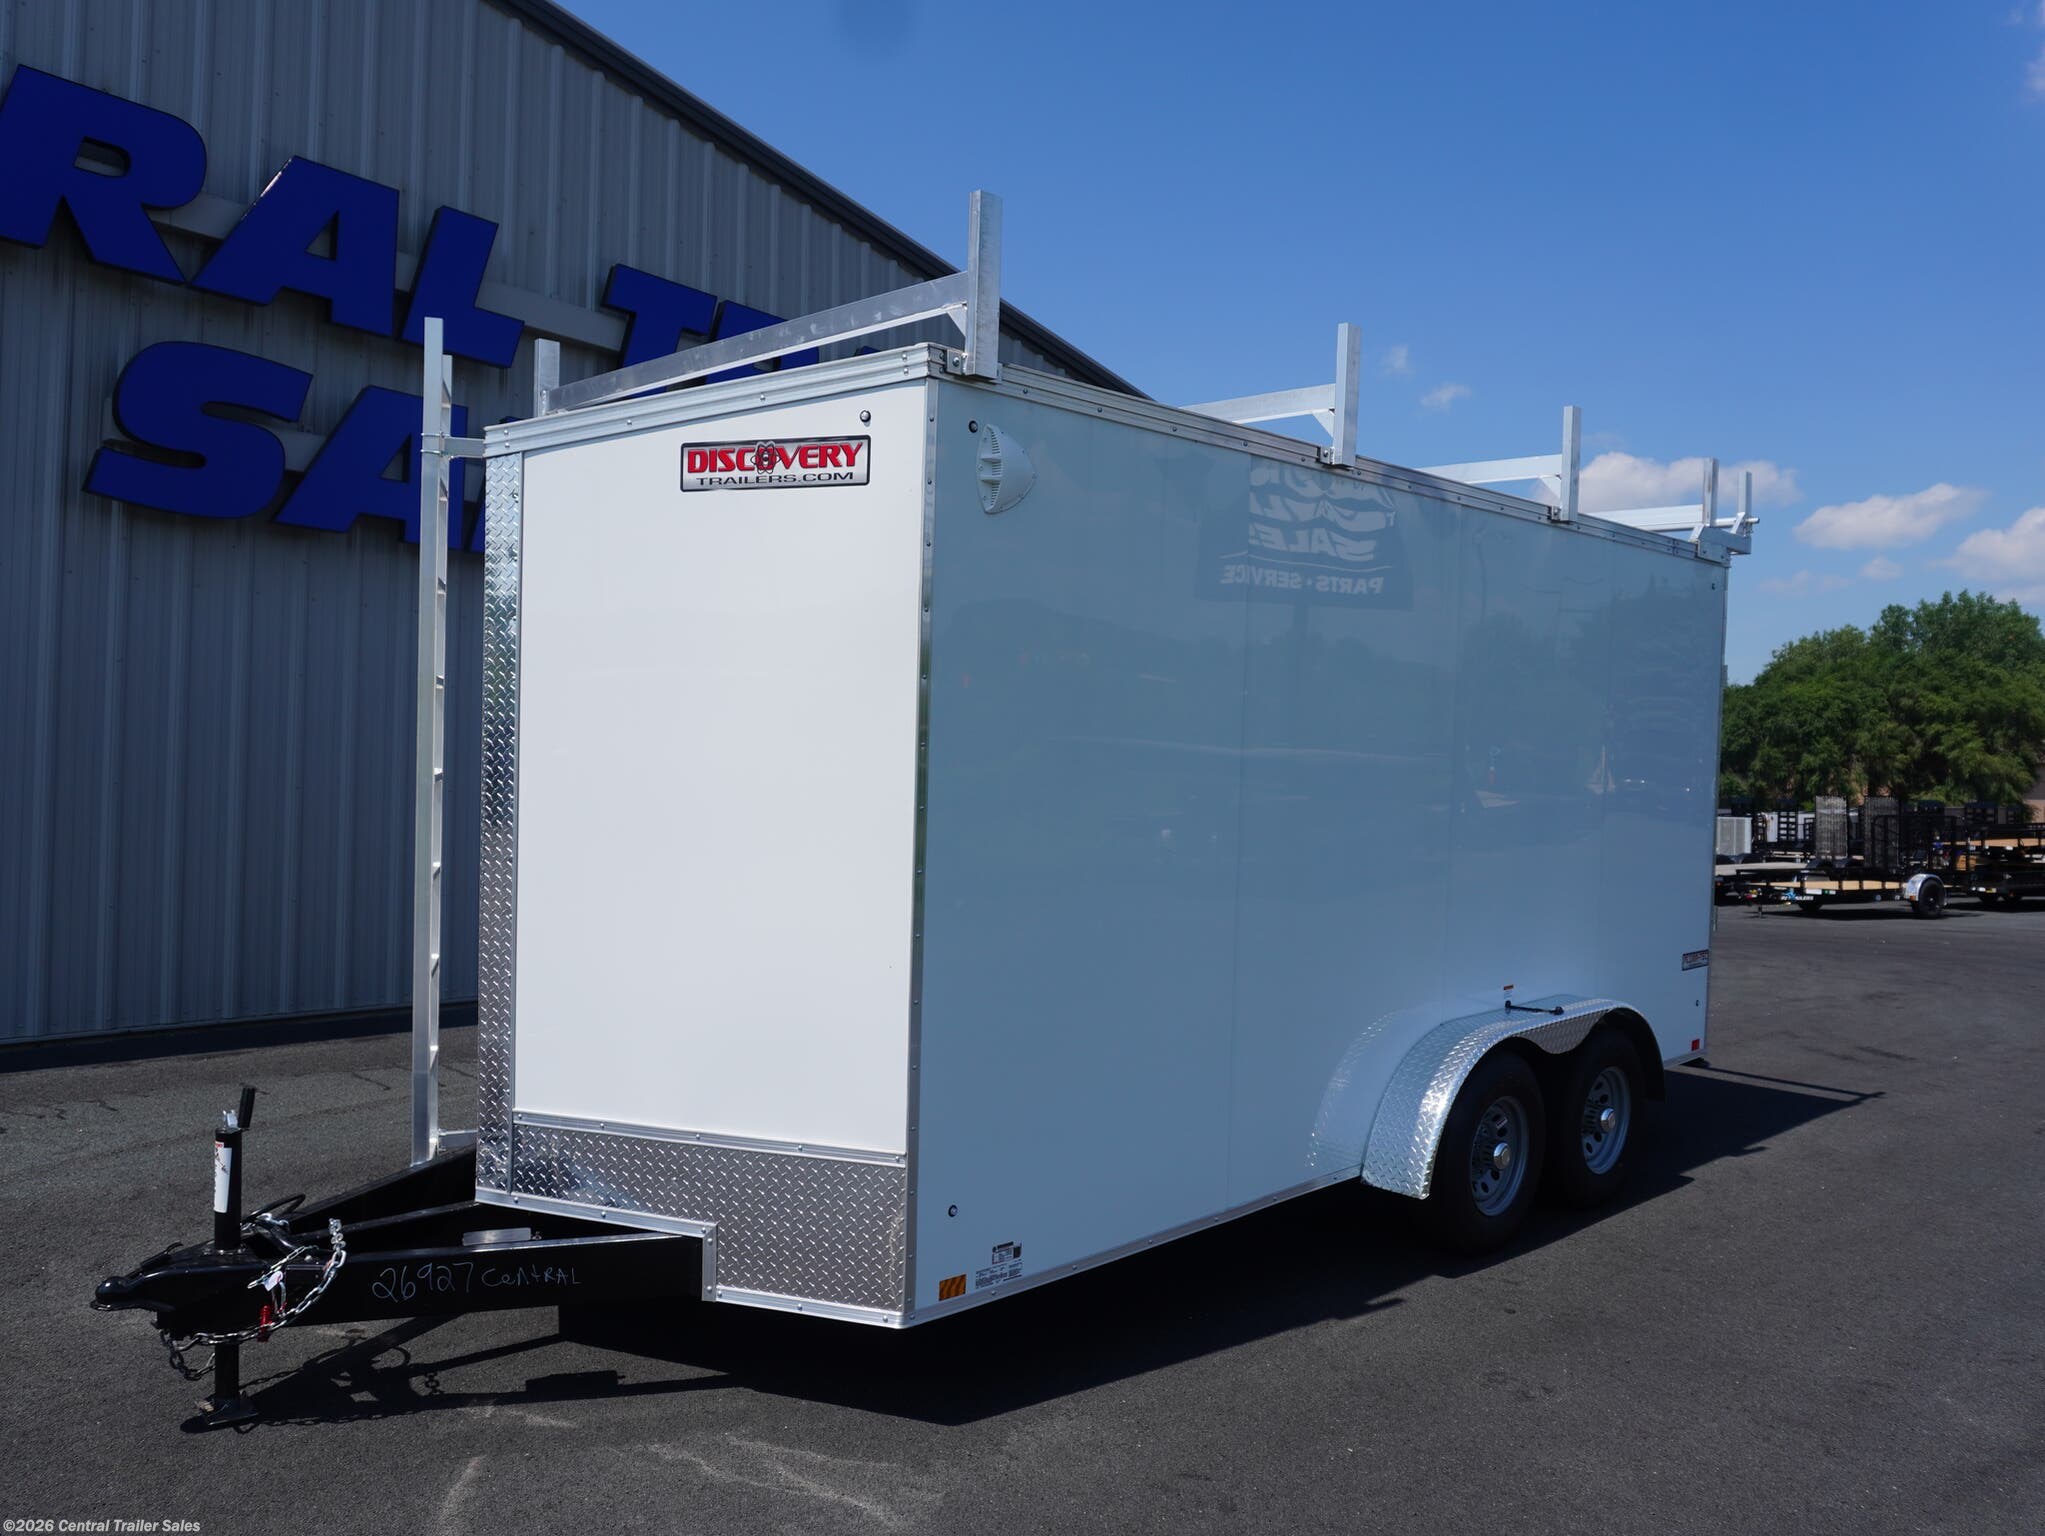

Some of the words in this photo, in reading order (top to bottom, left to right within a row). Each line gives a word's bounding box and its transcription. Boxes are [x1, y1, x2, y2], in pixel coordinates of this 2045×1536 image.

[687, 441, 863, 474] DISCOVERY
[696, 471, 854, 486] TRAILERS.COM
[371, 1262, 474, 1303] 26927
